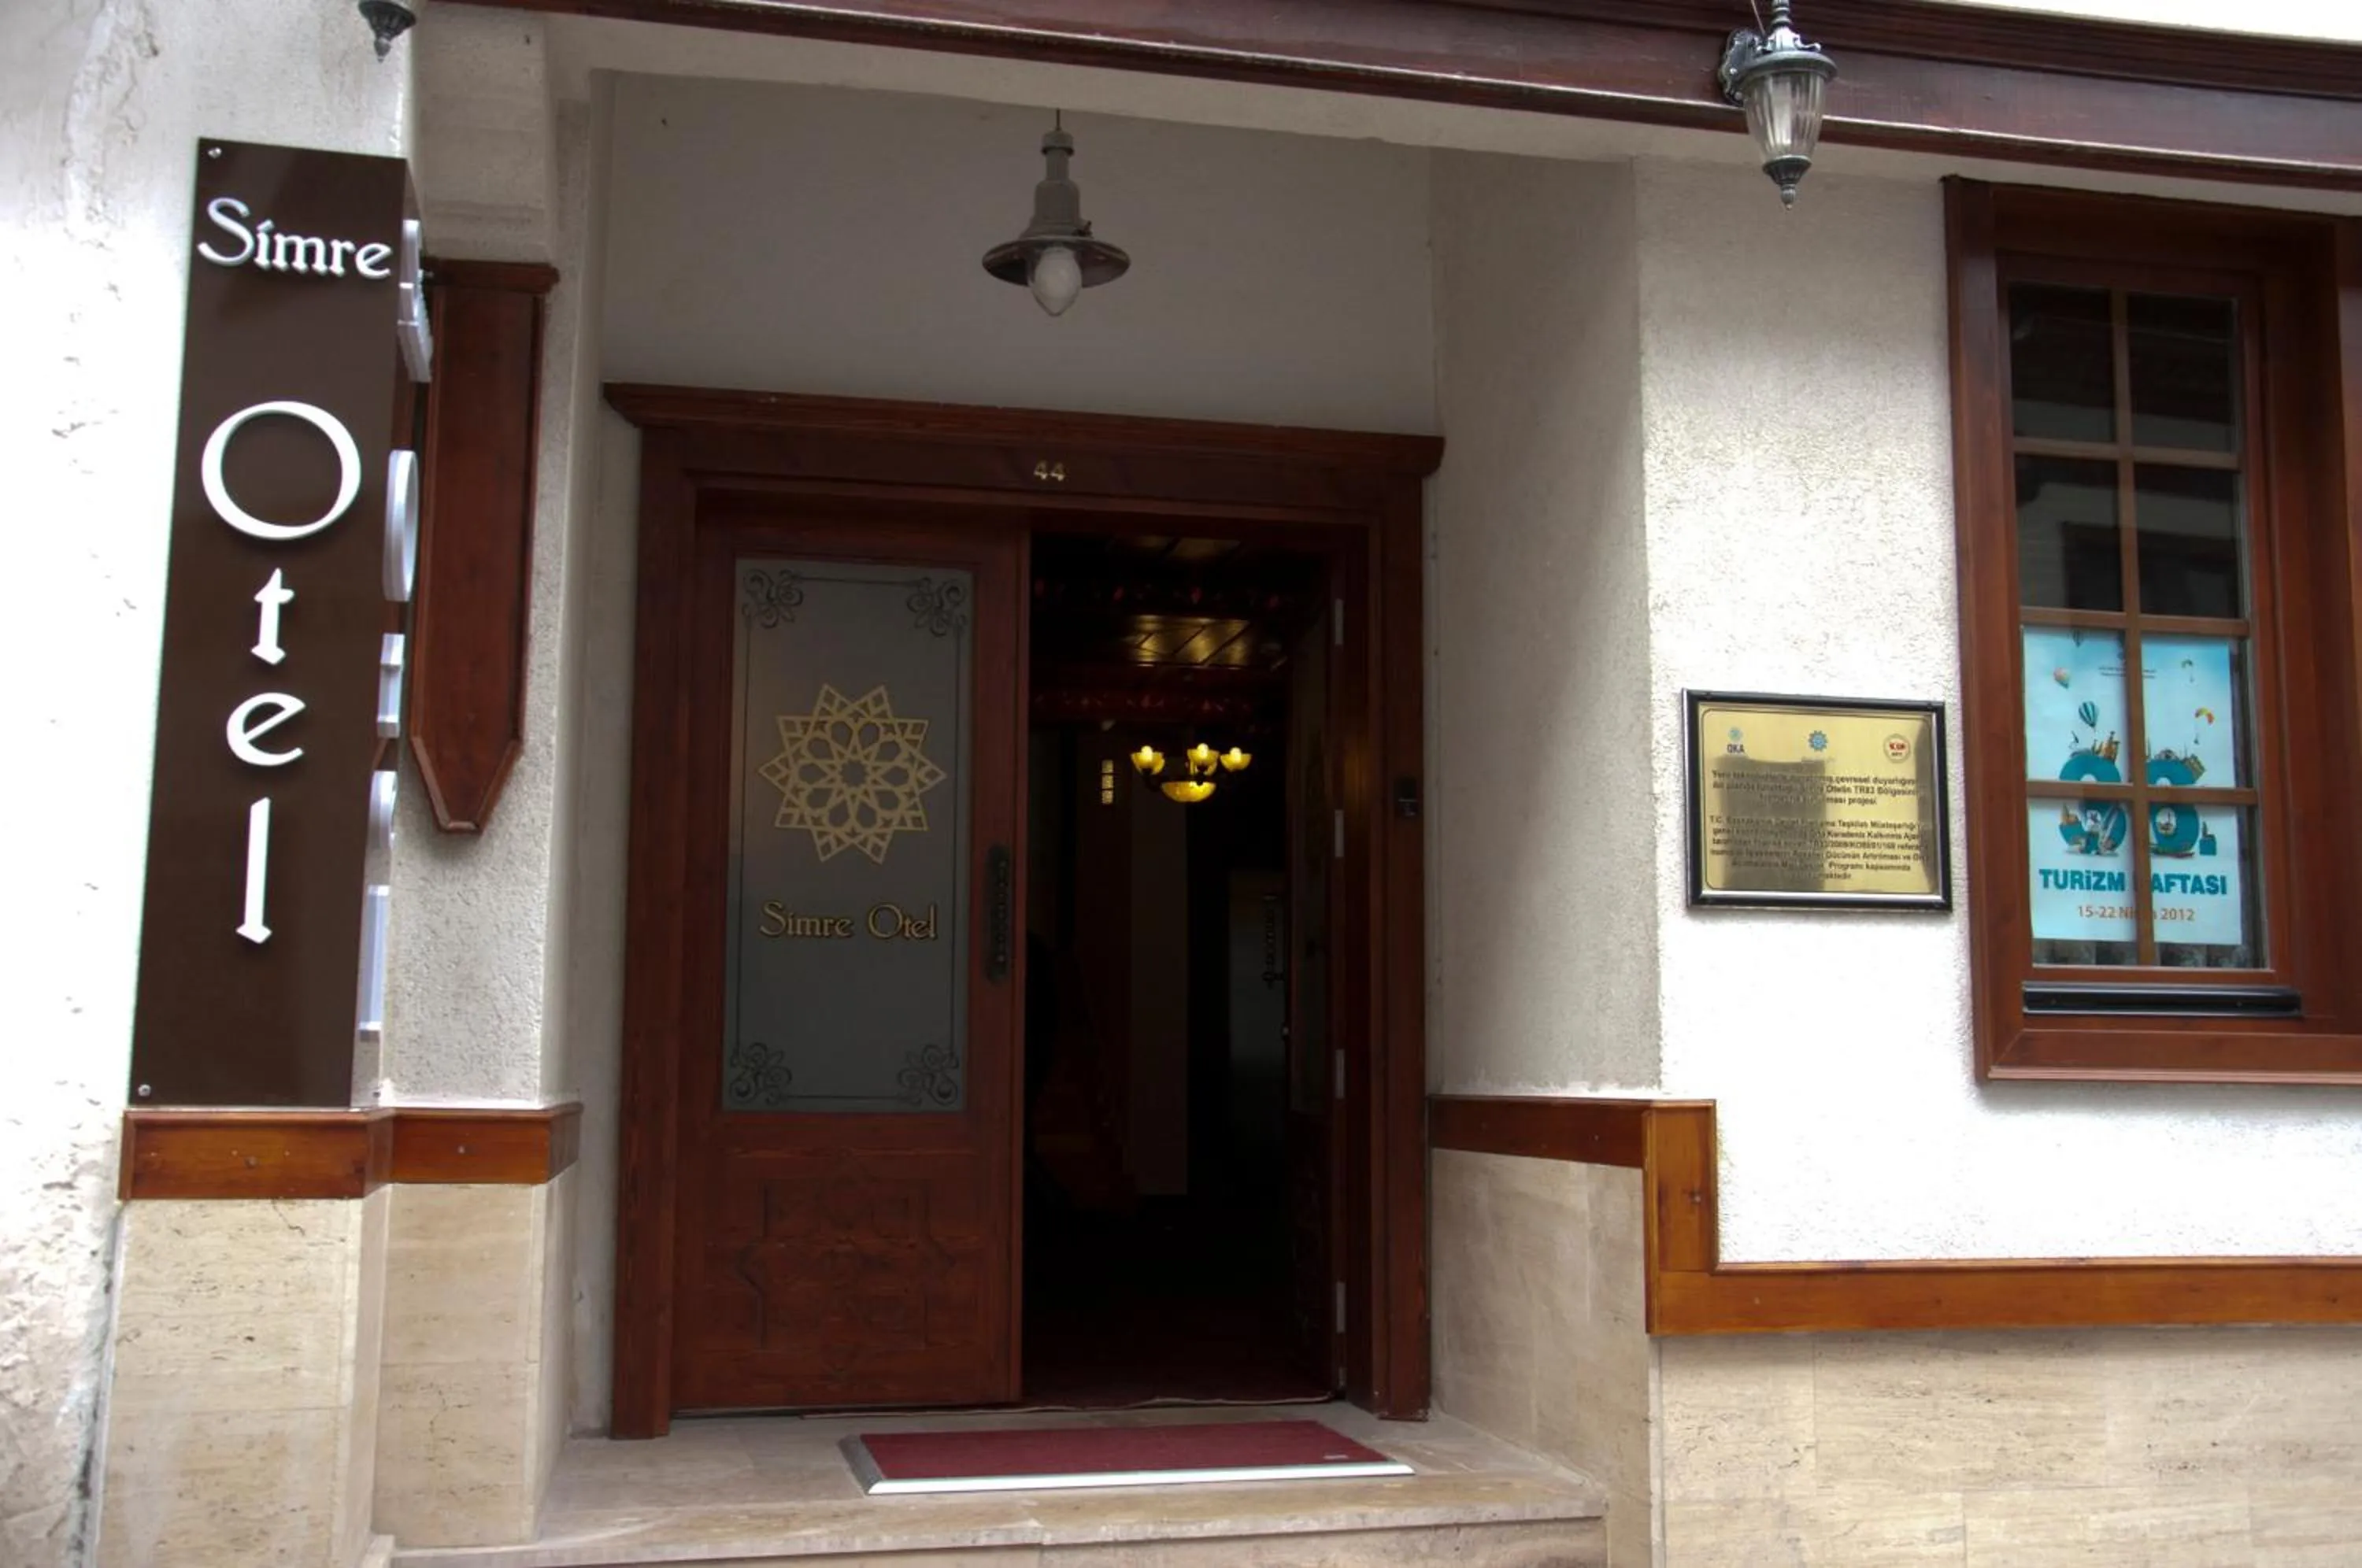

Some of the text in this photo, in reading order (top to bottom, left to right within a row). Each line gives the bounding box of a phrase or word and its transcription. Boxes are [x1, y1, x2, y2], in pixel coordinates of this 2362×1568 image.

[1033, 460, 1065, 482] 44
[202, 401, 361, 945] Otel
[2134, 872, 2227, 895] AFTASI
[759, 900, 937, 939] Simre Otel
[2079, 906, 2117, 919] 15-22
[2160, 908, 2195, 921] 2012
